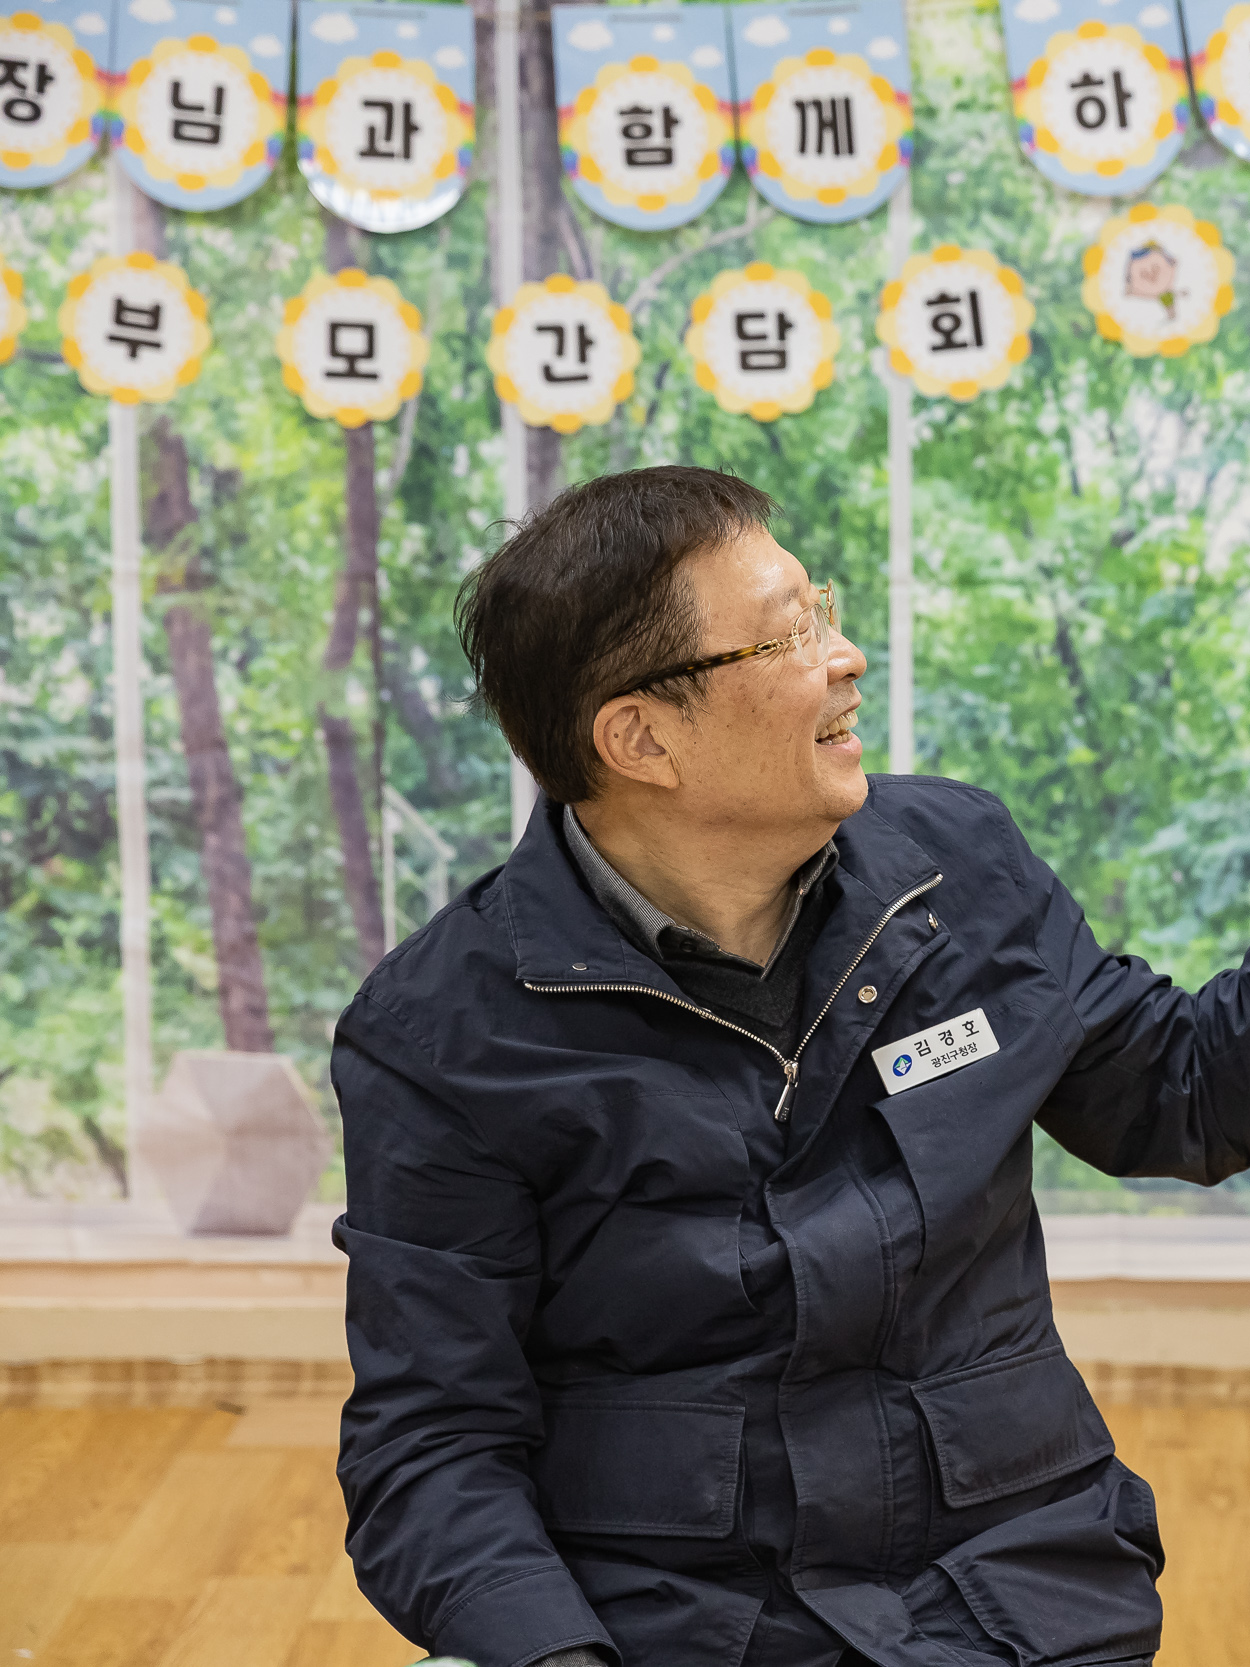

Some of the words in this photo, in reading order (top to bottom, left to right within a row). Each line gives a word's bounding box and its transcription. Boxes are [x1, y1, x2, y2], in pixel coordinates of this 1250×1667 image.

[618, 96, 855, 168] 함께
[914, 1020, 980, 1057] 김경호
[931, 1042, 978, 1069] 광진구청장
